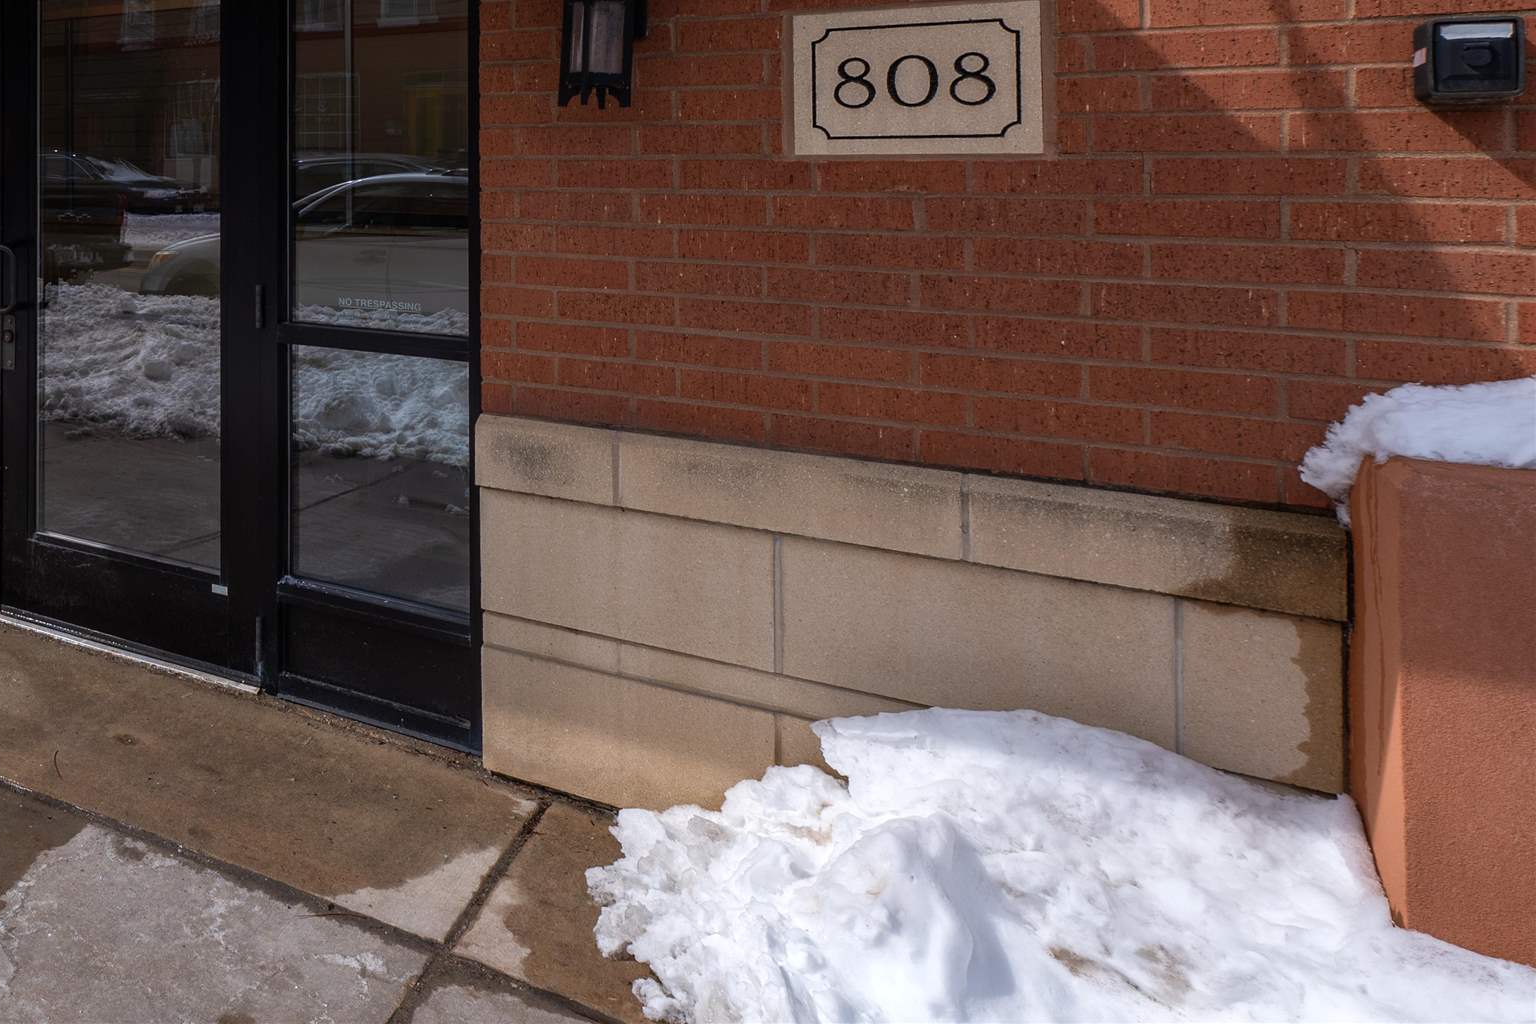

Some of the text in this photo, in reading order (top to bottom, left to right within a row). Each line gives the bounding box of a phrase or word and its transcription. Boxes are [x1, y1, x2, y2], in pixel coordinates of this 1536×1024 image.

[833, 51, 997, 109] 808
[338, 297, 422, 312] NO TRESPASSING
